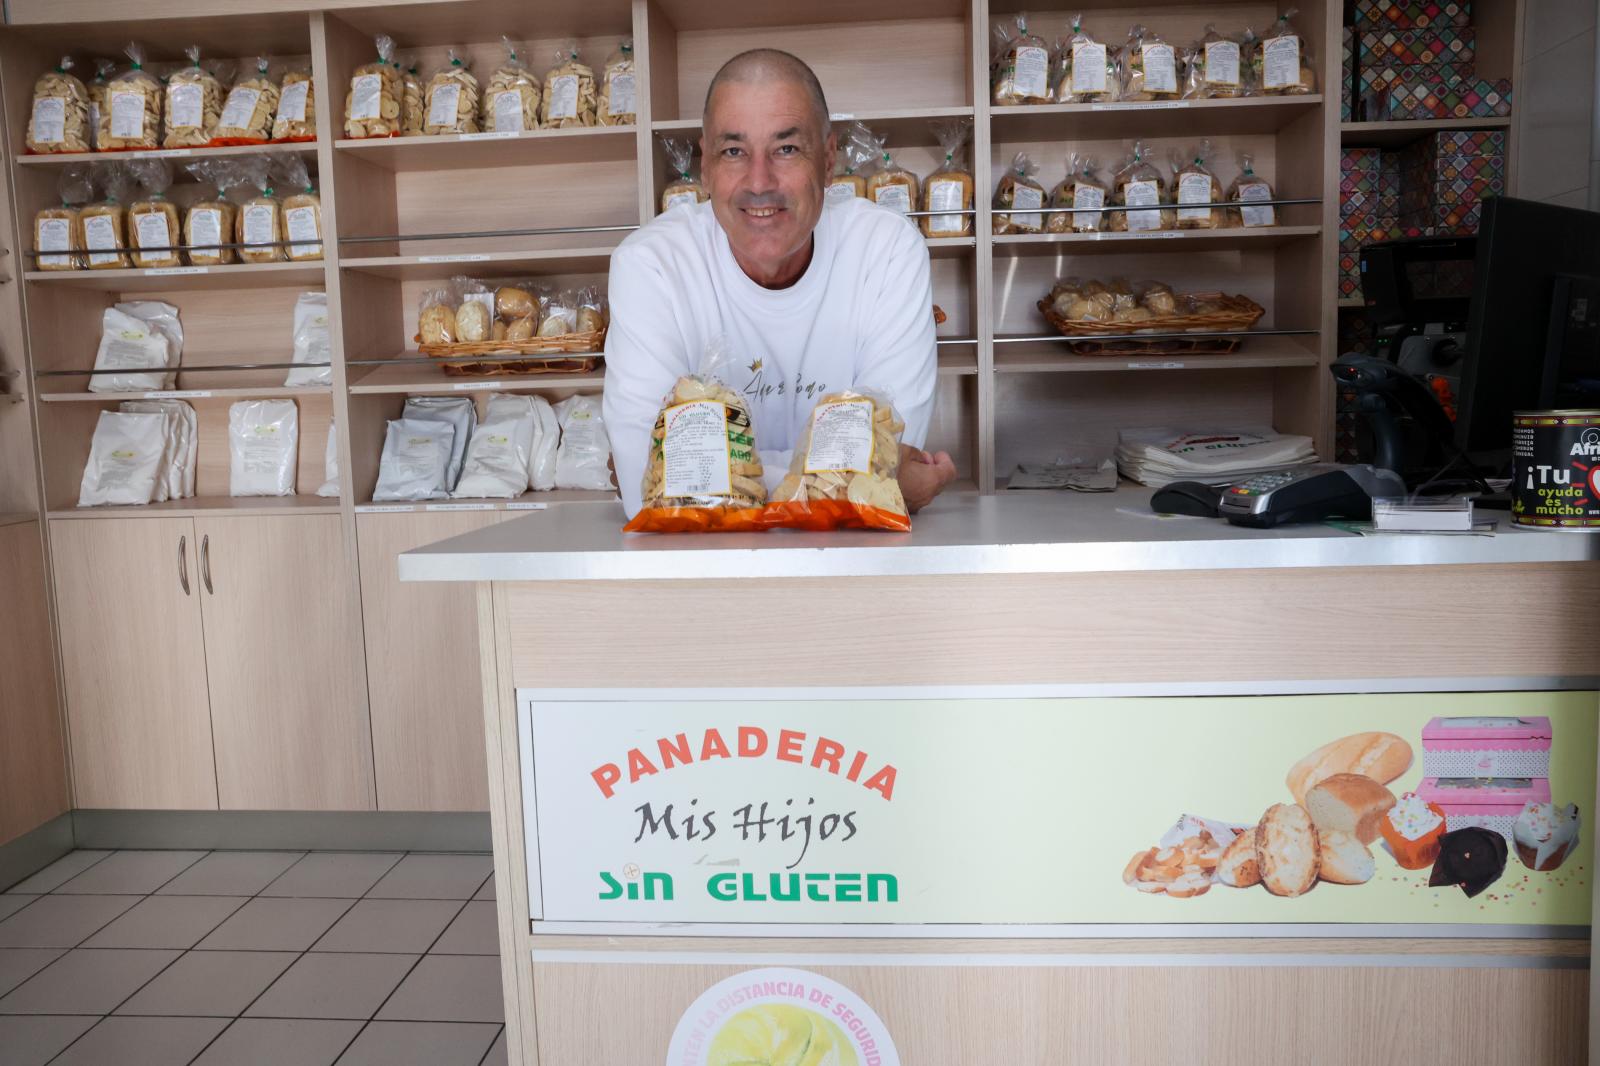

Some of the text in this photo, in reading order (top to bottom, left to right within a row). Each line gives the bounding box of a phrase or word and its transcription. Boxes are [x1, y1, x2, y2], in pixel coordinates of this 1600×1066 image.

[1526, 465, 1571, 490] ¡Tu
[1538, 486, 1583, 499] ayuda
[1545, 498, 1562, 507] es
[1535, 504, 1584, 515] mucho
[590, 726, 898, 801] PANADERIA
[634, 797, 858, 870] Mis Hijos
[706, 872, 899, 902] GLUTEN
[697, 1008, 721, 1029] LA
[717, 981, 806, 1014] DISTANCIA
[808, 988, 834, 1009] DE
